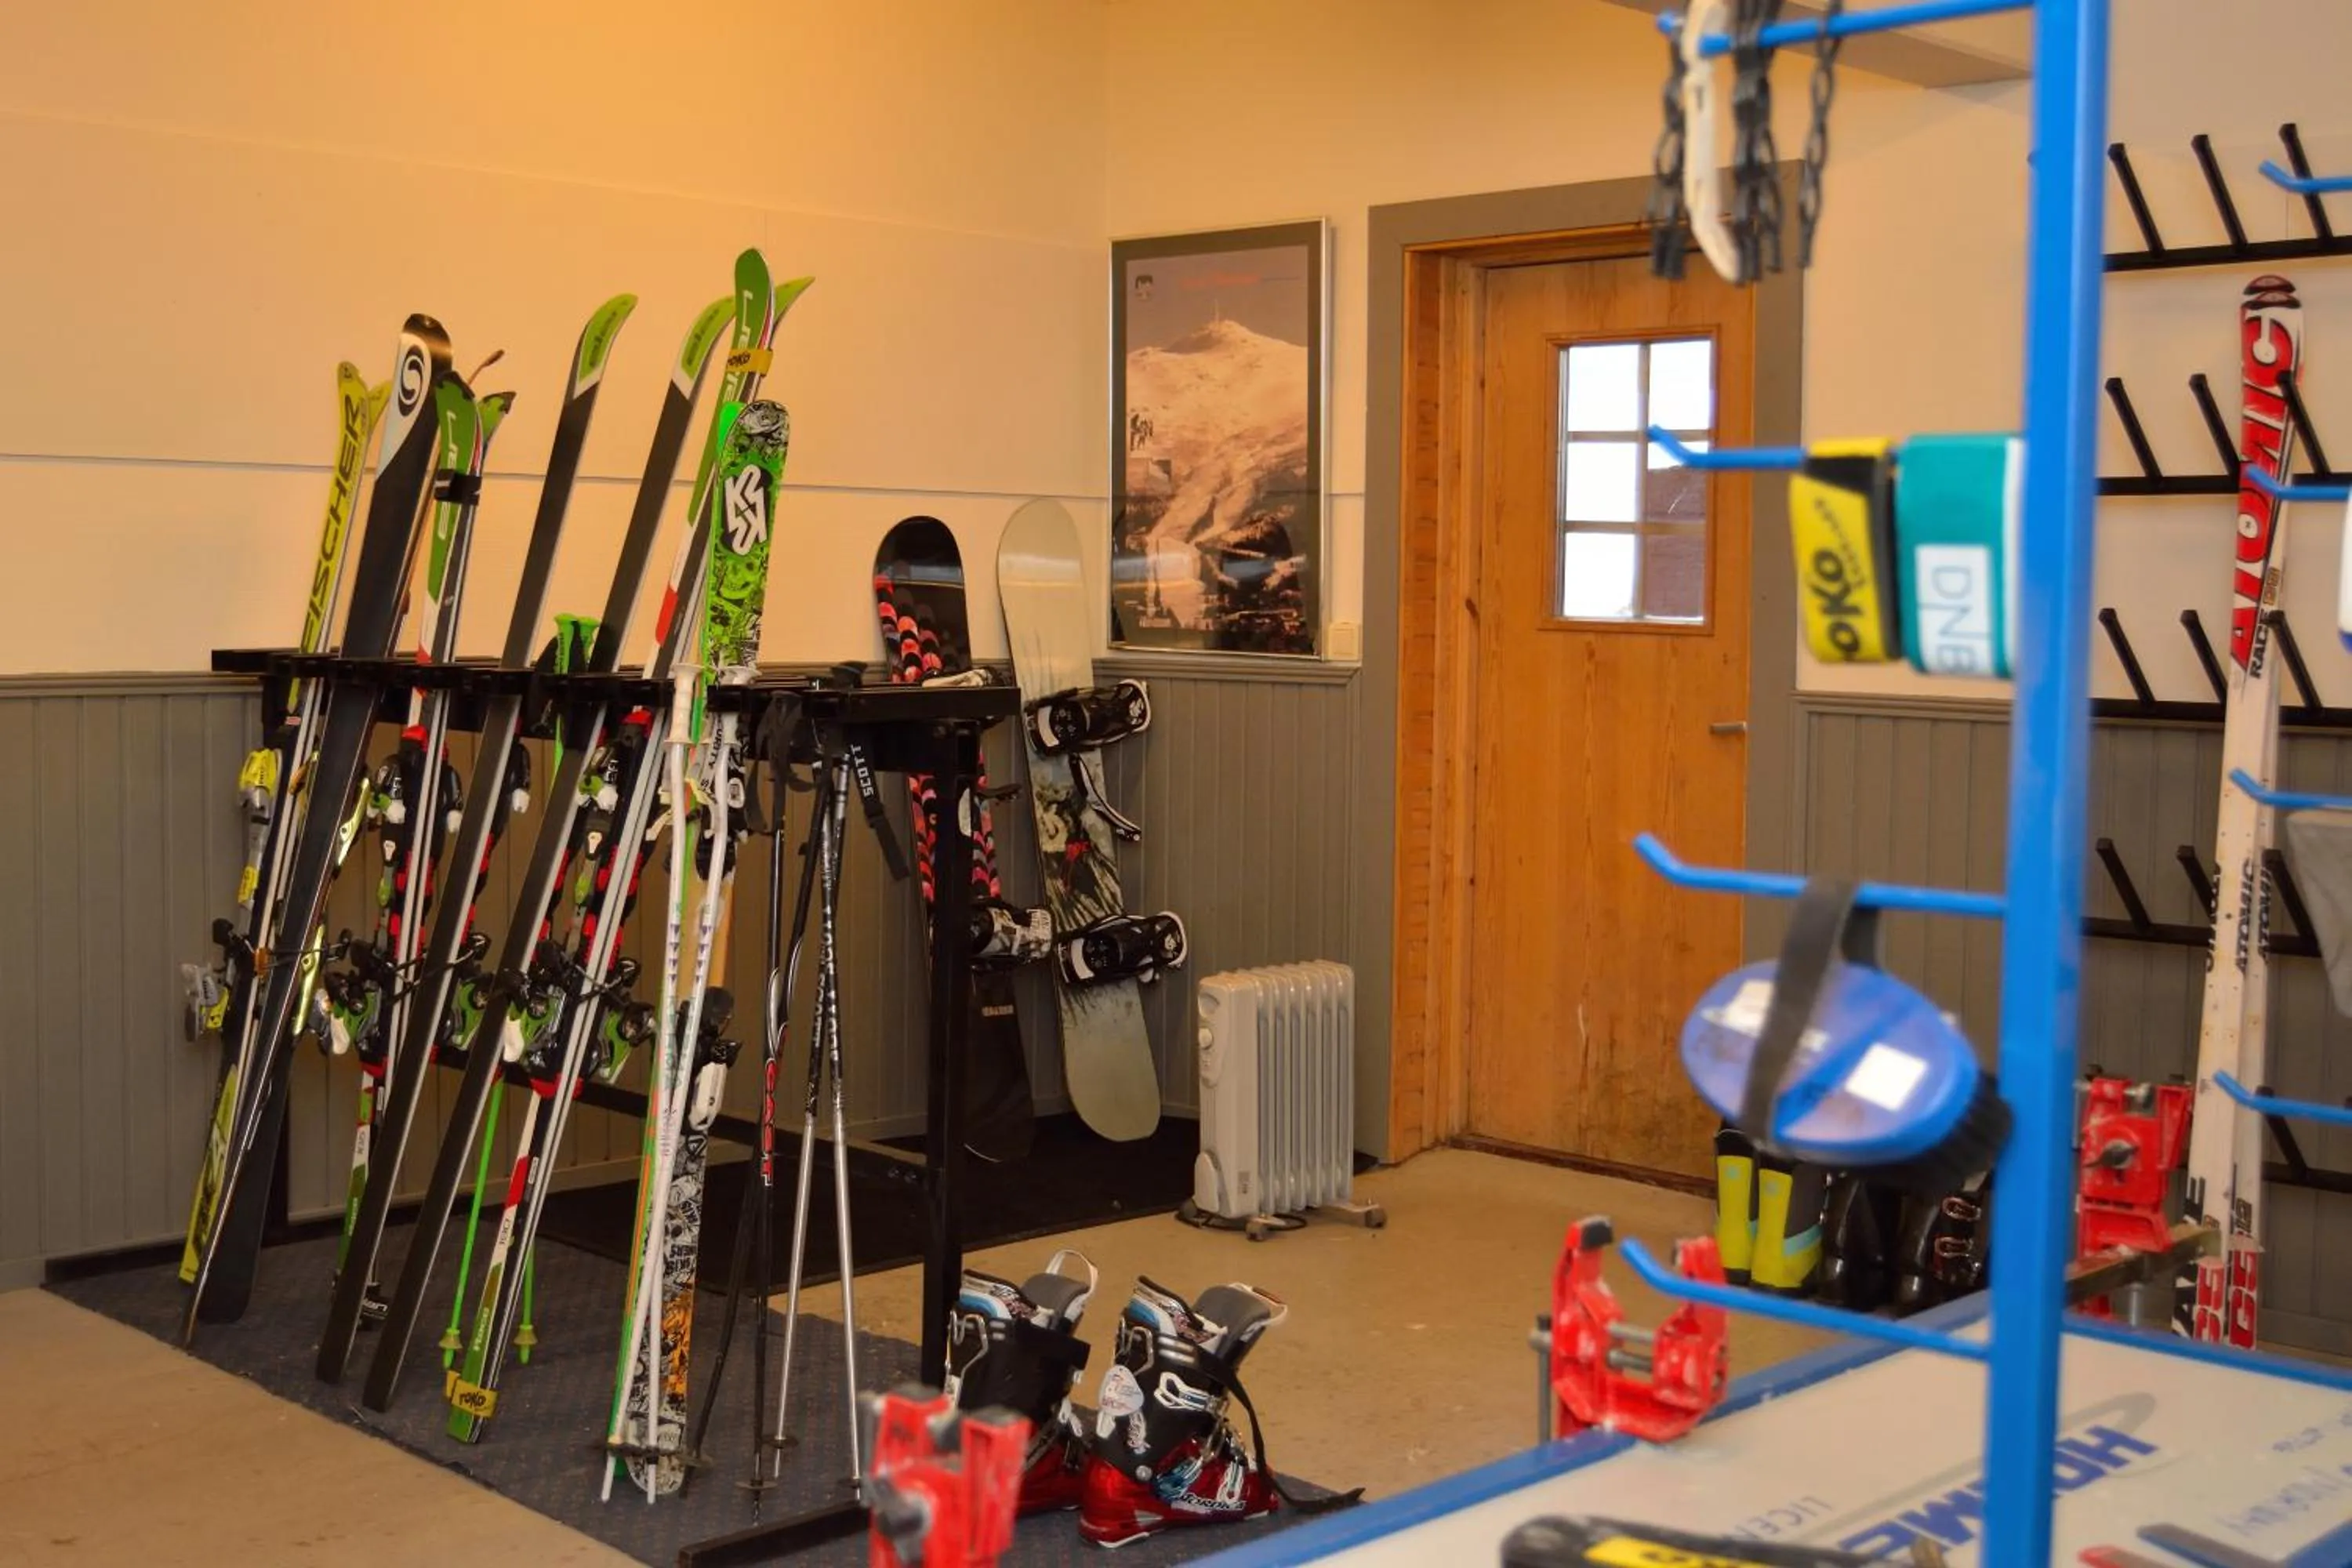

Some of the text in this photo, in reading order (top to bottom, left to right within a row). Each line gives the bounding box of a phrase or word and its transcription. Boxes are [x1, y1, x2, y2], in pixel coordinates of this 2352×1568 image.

[301, 394, 365, 652] FISCHER
[2230, 315, 2294, 672] ATOMIC
[1806, 549, 1864, 660] OKO
[850, 743, 874, 797] SCOTT
